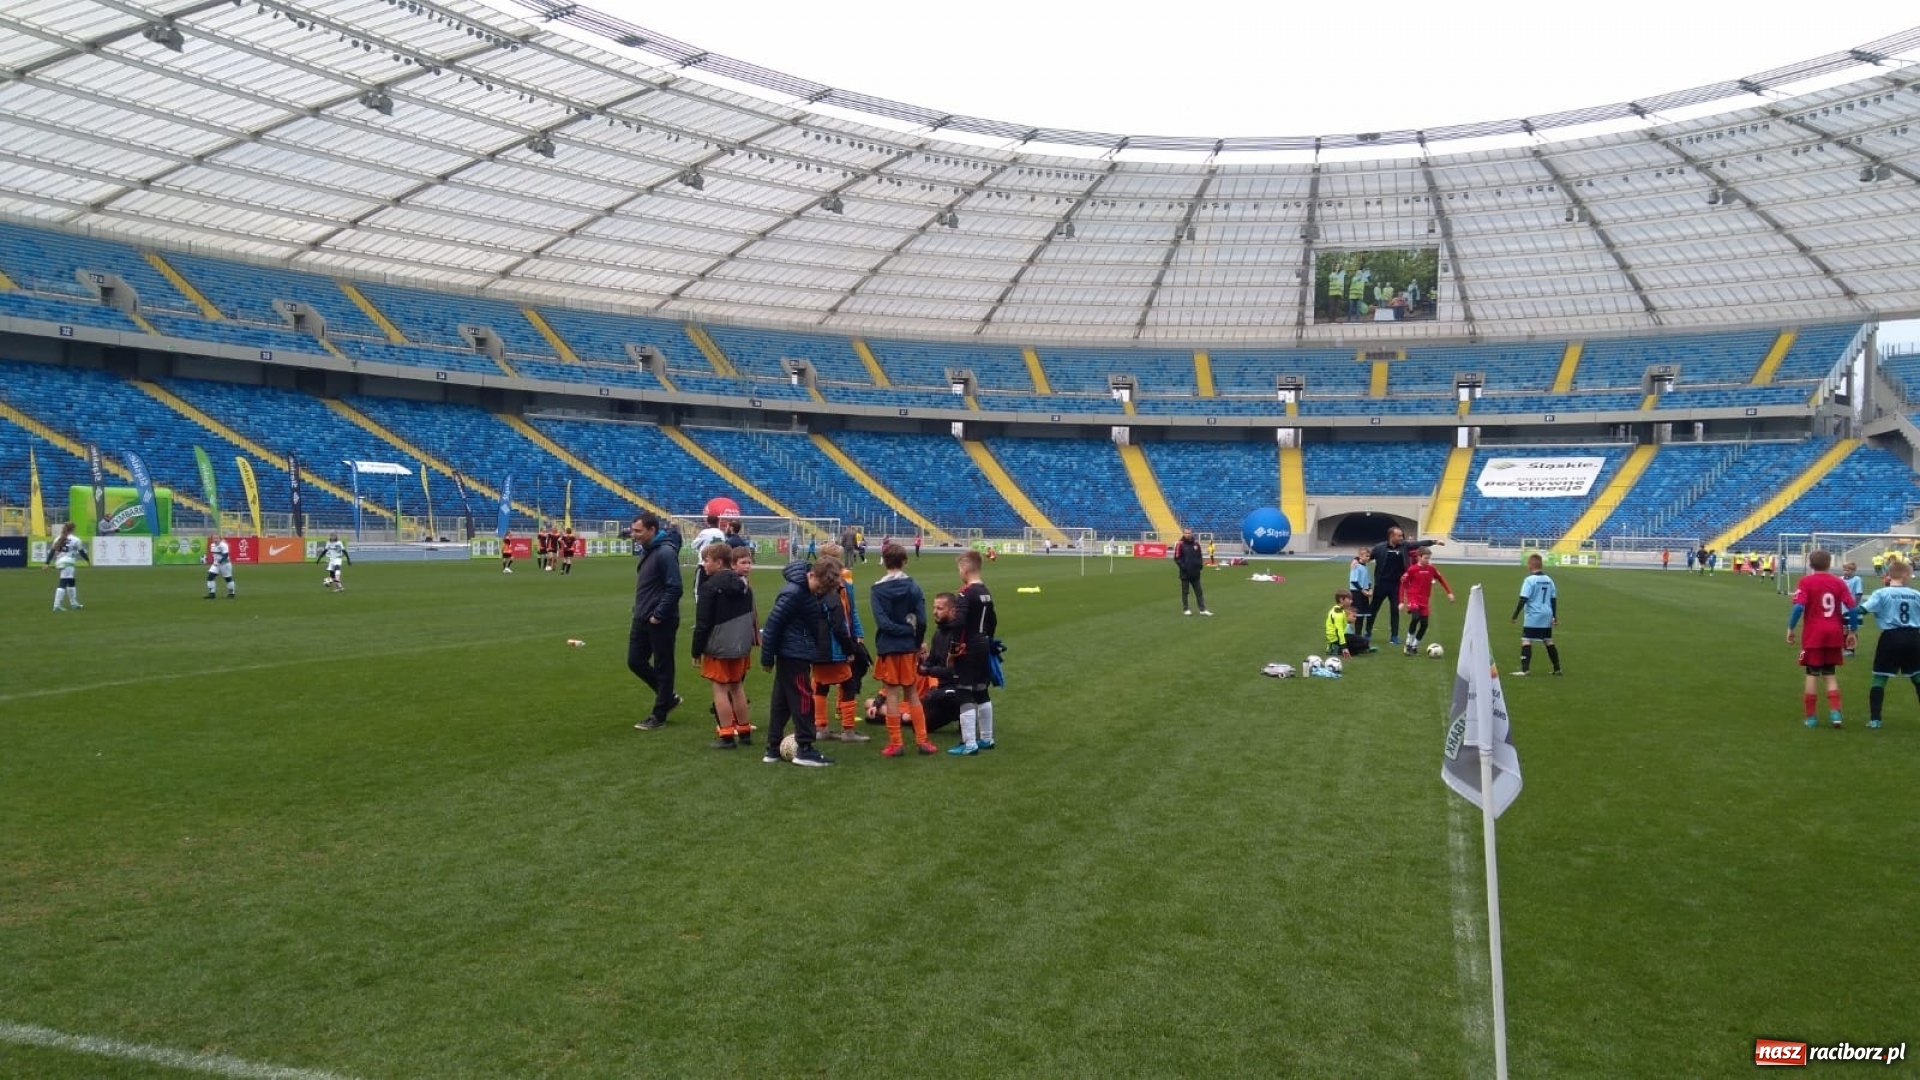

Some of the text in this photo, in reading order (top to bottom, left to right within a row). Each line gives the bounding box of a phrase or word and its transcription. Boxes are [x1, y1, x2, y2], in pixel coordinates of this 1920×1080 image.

[1541, 586, 1549, 604] 7
[1822, 593, 1836, 618] 9
[979, 605, 987, 633] 1
[1900, 602, 1910, 625] 8
